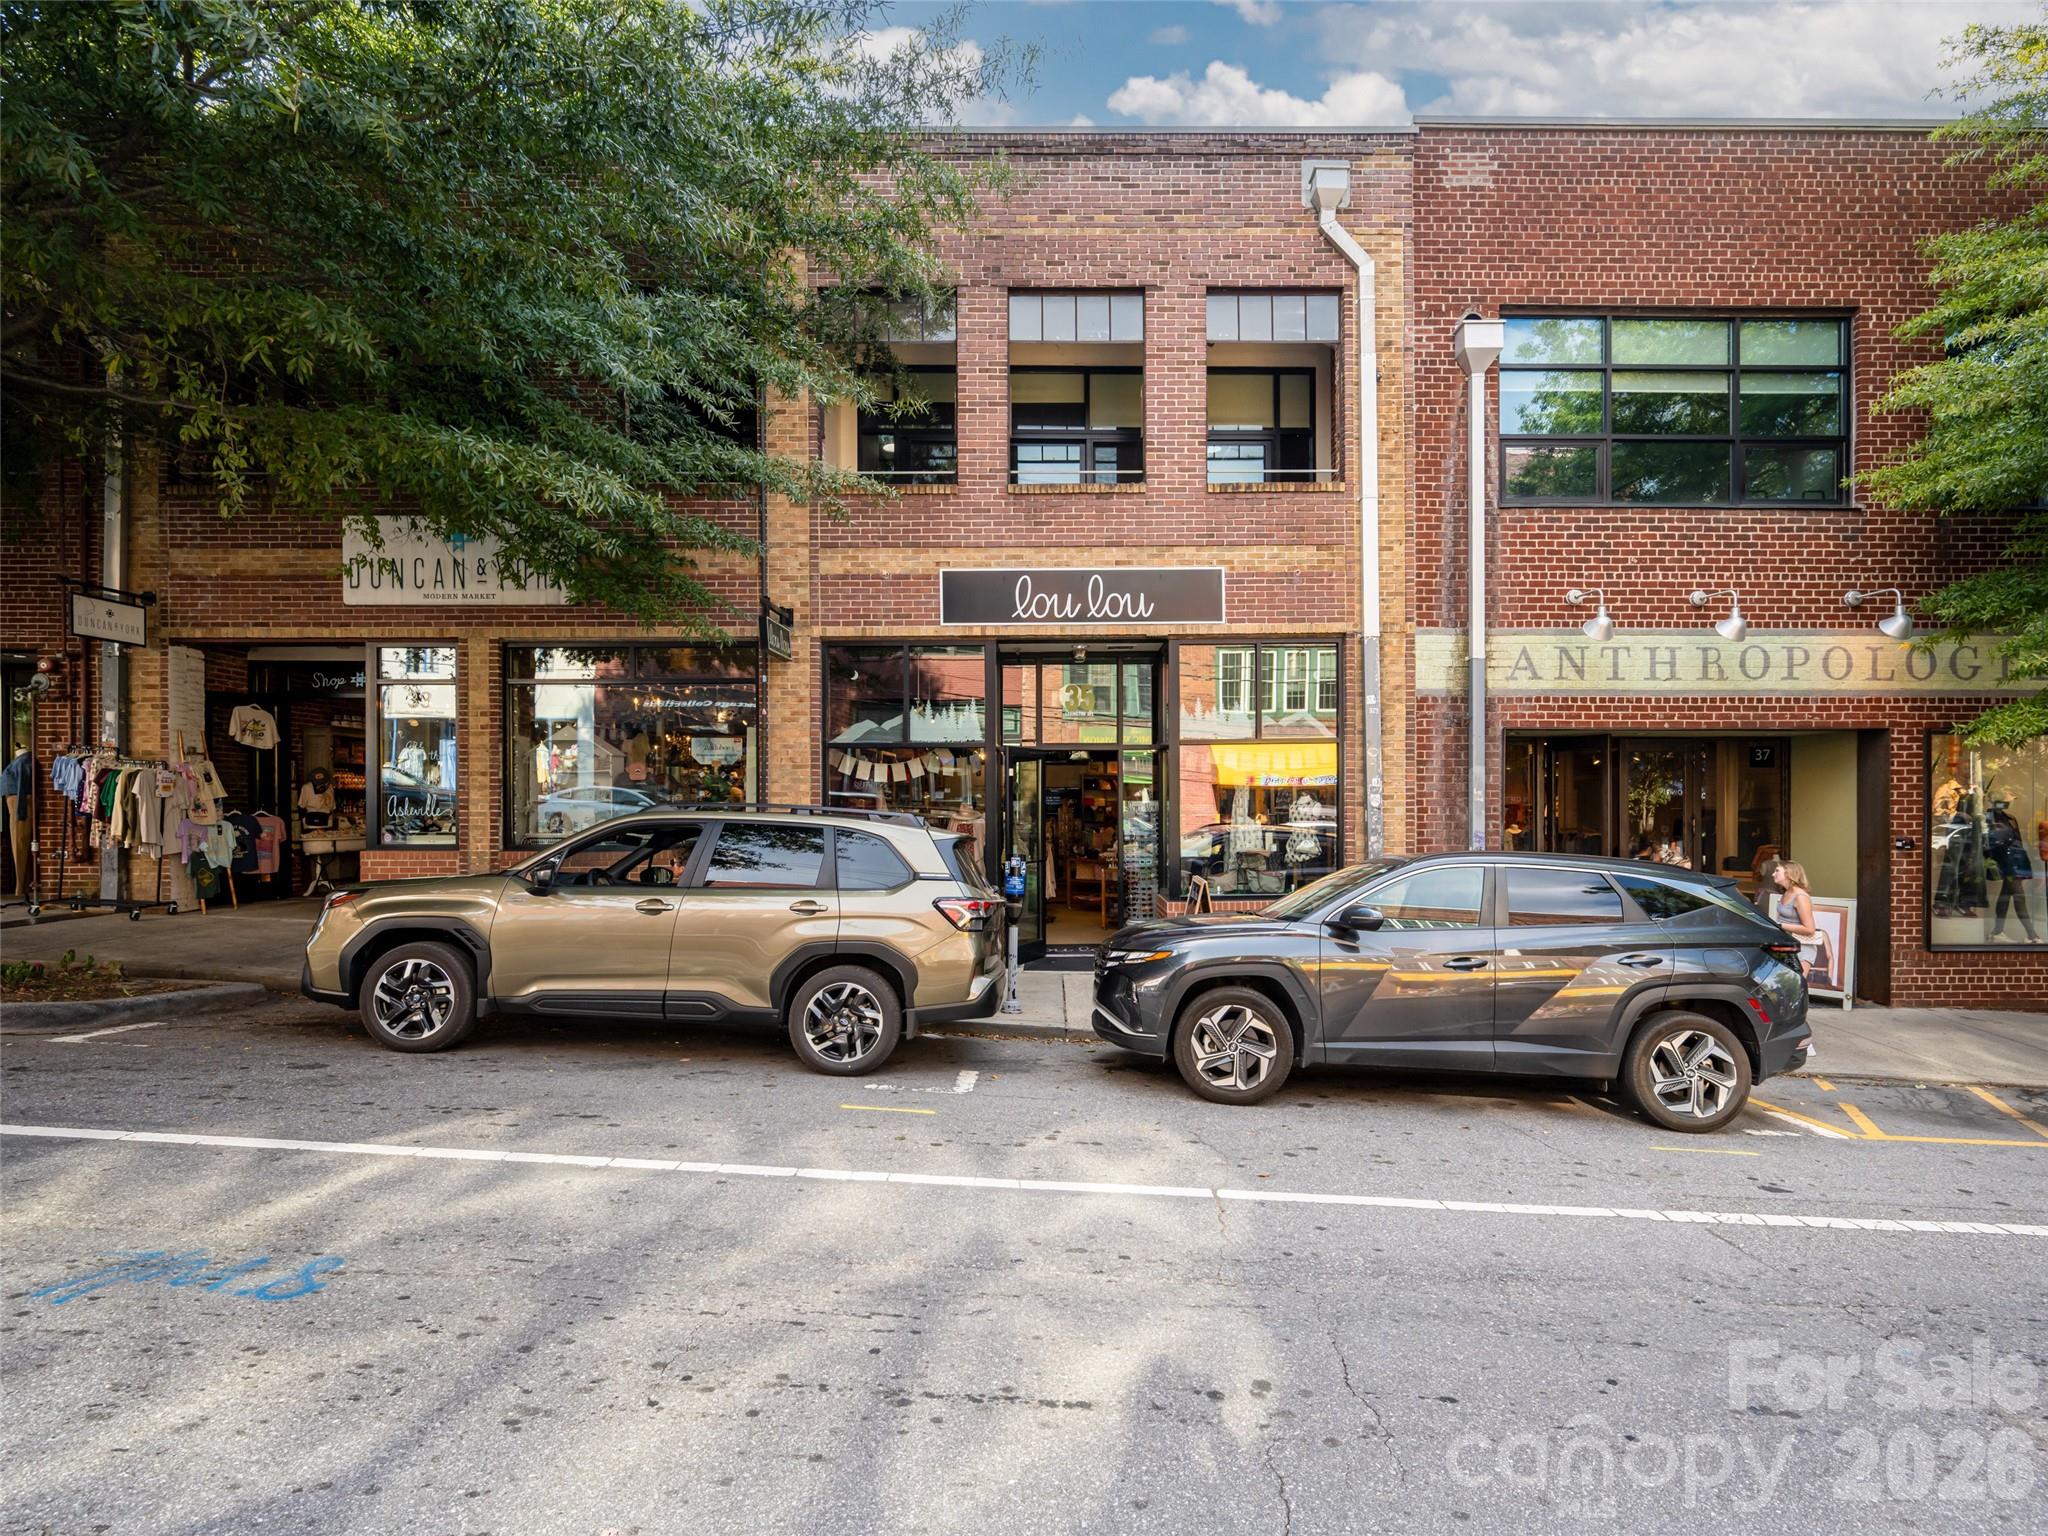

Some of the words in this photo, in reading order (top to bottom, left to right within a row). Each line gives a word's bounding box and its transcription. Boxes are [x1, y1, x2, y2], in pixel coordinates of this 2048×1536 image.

[349, 557, 465, 590] DUNCAN
[476, 557, 488, 584] &
[1011, 574, 1082, 619] lou
[1087, 574, 1154, 618] lou
[77, 615, 113, 631] DUNCAN
[1505, 644, 2048, 682] ANTHROPOLOGI
[312, 671, 347, 690] Shop
[1064, 684, 1095, 712] 35
[1754, 748, 1770, 761] 37
[387, 793, 452, 818] Asheville
